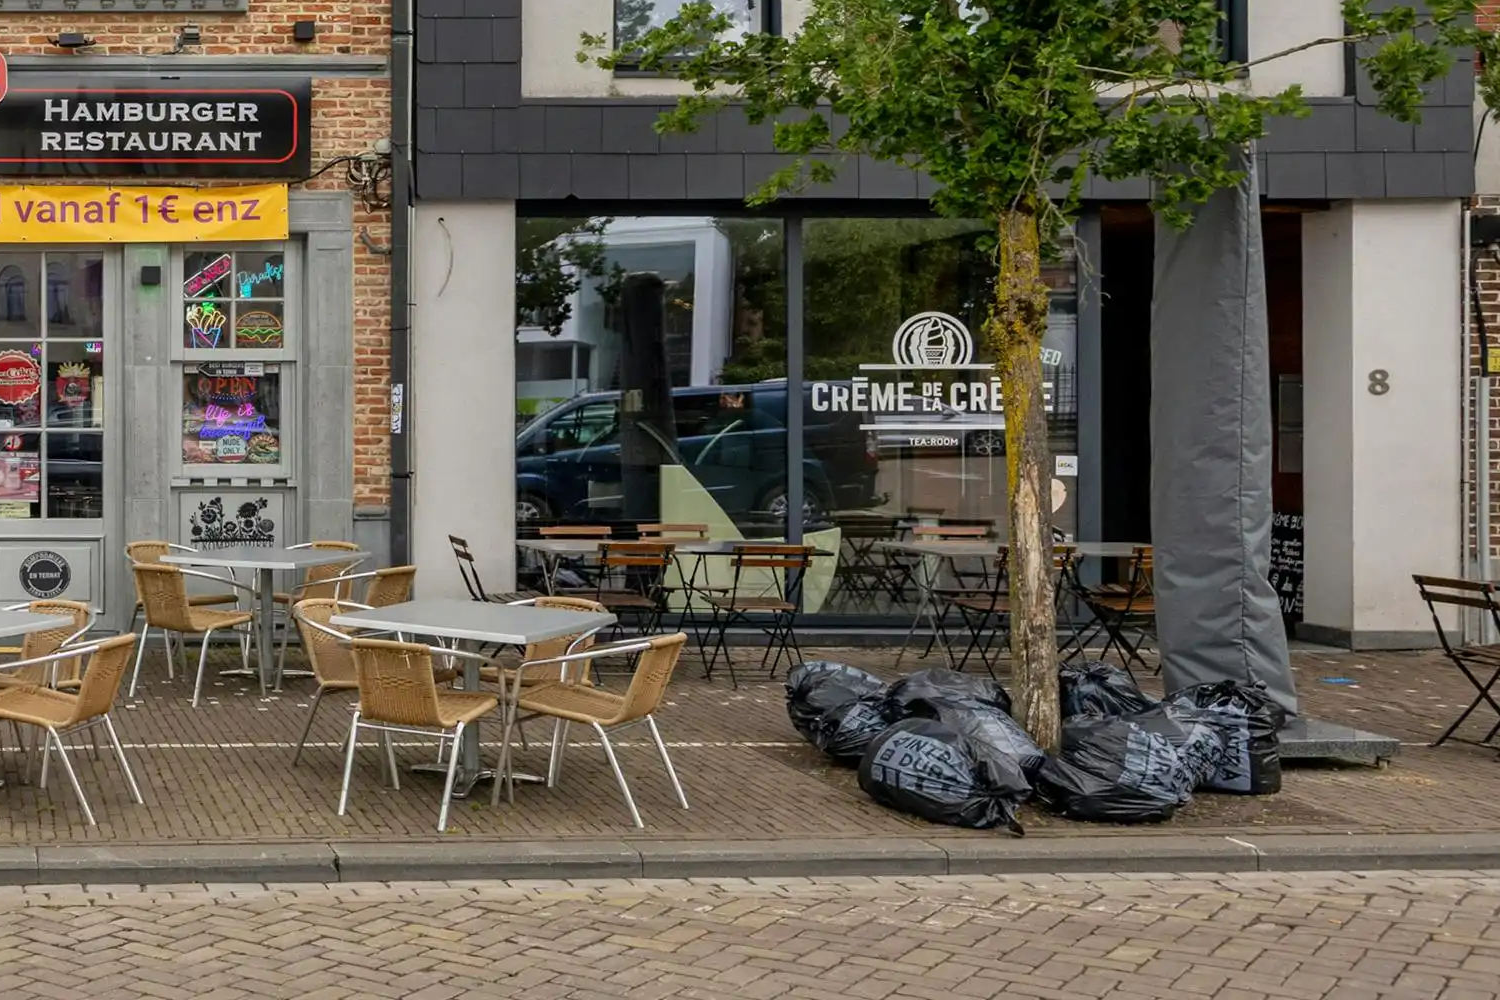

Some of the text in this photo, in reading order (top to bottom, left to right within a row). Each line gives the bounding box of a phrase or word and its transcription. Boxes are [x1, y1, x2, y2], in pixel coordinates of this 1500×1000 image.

[44, 99, 259, 122] HAMBURGER
[41, 131, 262, 151] RESTAURANT
[14, 192, 121, 224] vanaf
[134, 195, 180, 224] 1€
[193, 198, 261, 224] enz
[922, 382, 943, 397] DE
[1368, 369, 1390, 396] 8
[922, 398, 943, 412] LA
[909, 437, 958, 447] TEA-ROOM
